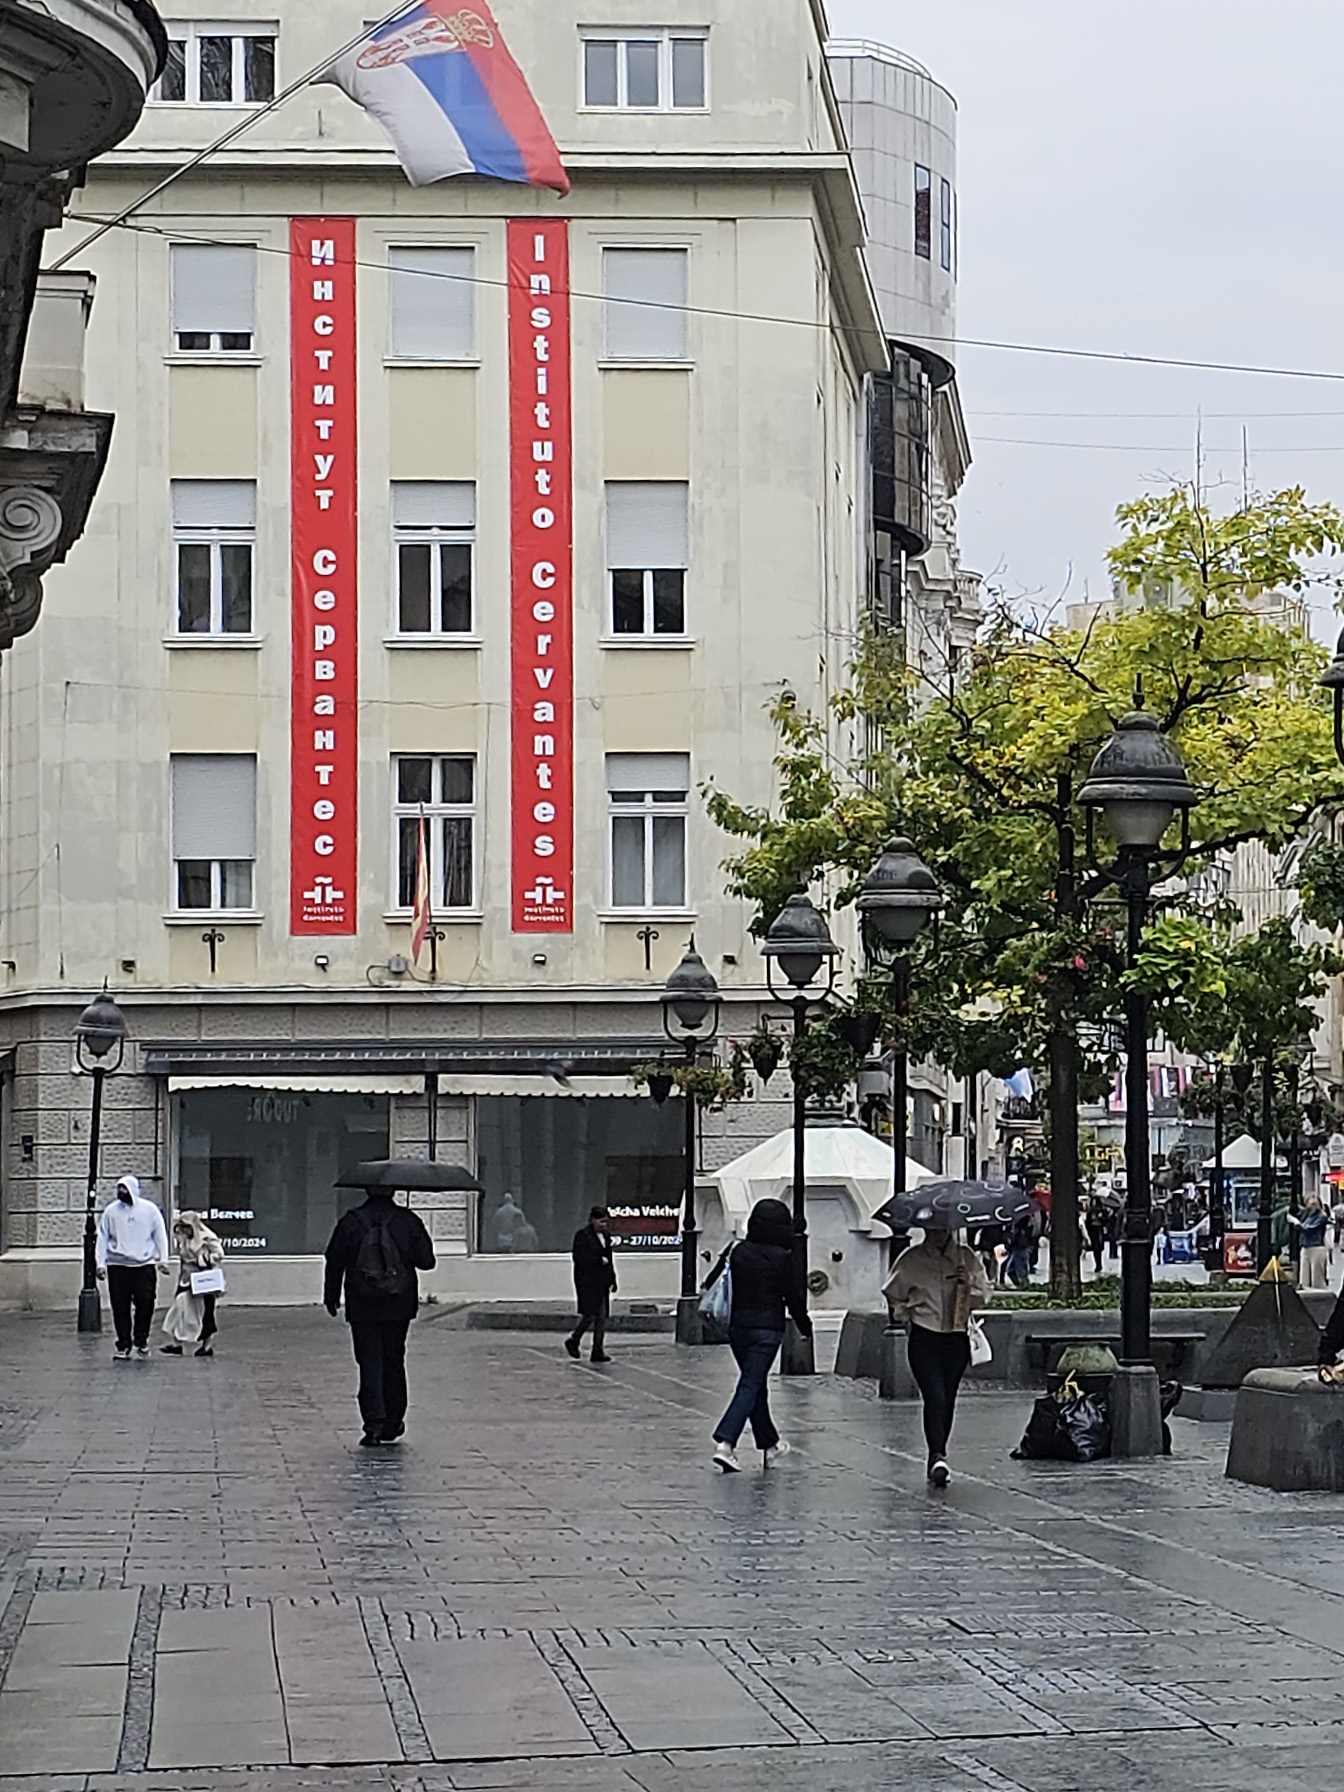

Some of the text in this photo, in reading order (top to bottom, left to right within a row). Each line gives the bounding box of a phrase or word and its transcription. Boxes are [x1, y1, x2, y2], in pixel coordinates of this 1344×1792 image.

[313, 549, 337, 856] Сервантес
[529, 234, 556, 856] Instituto Cervantes
